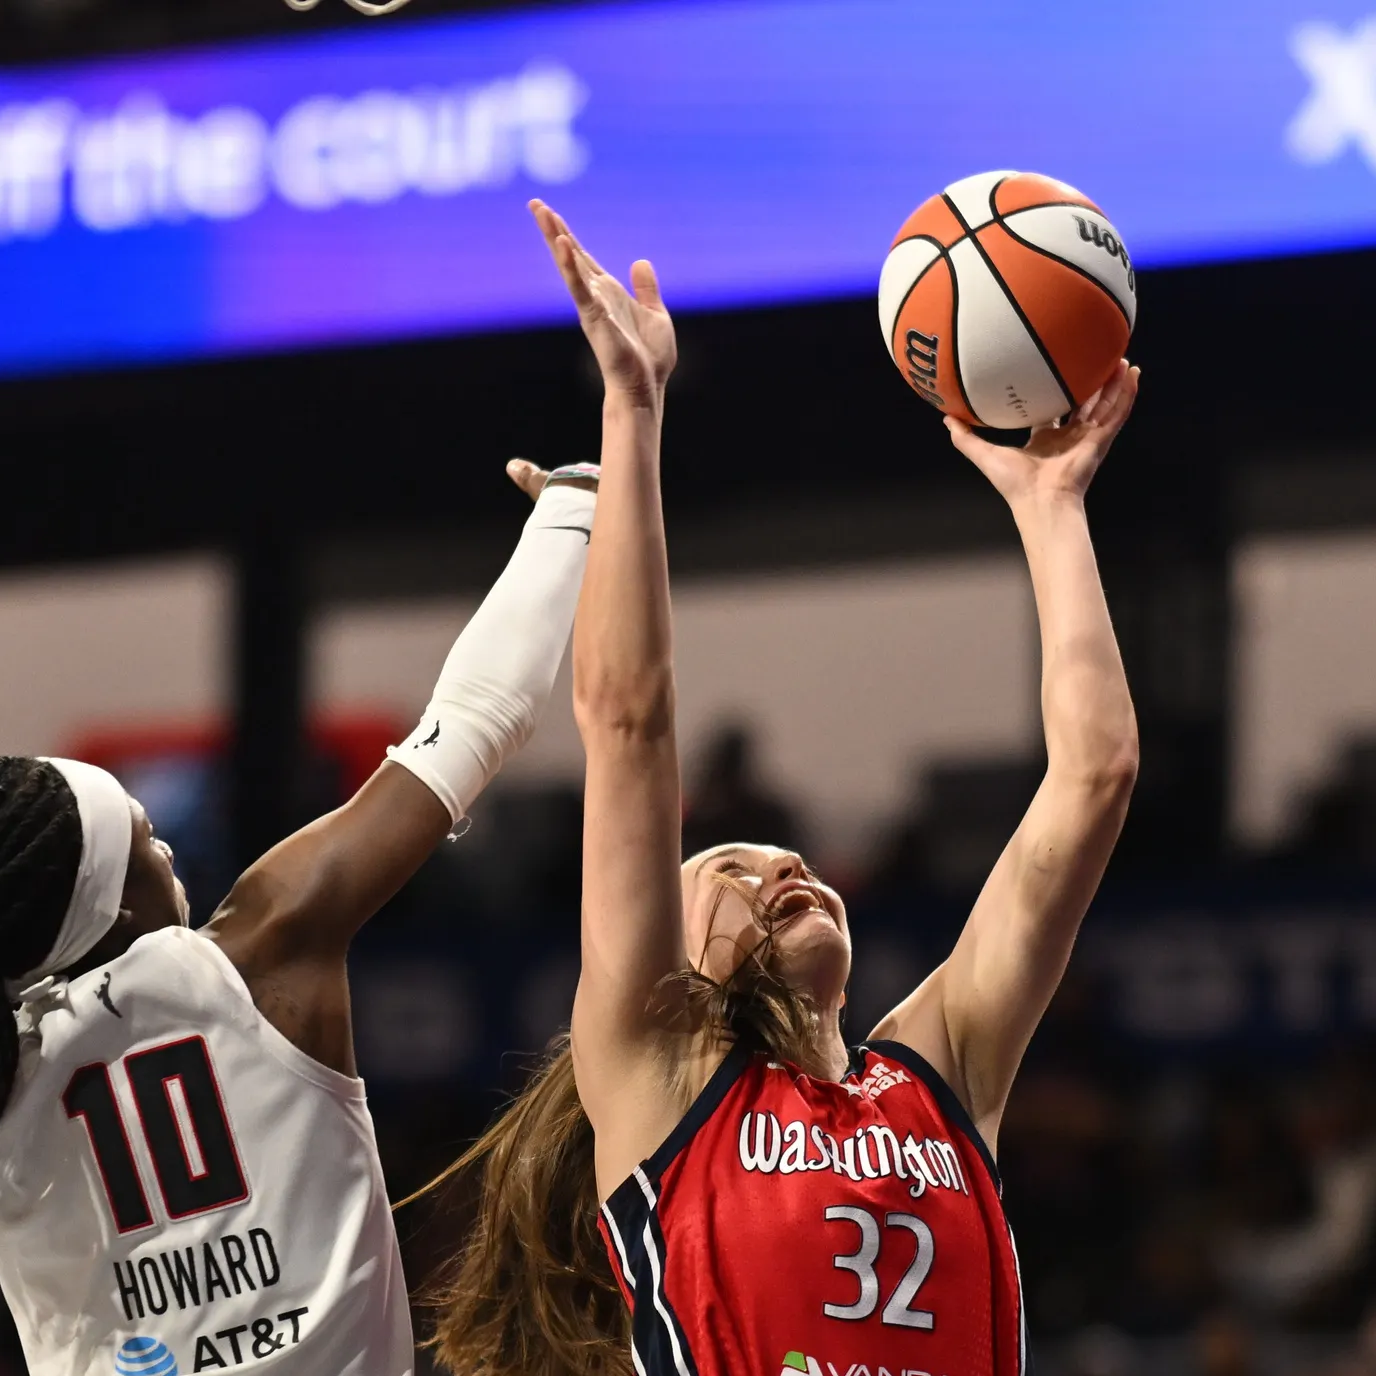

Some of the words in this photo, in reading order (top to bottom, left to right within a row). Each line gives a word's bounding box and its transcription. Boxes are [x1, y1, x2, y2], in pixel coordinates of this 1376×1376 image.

[71, 92, 272, 233] the
[272, 60, 588, 212] court
[61, 1034, 252, 1237] 10
[738, 1110, 969, 1200] Washington
[113, 1226, 281, 1322] HOWARD
[823, 1204, 936, 1331] 32
[193, 1306, 310, 1375] AT&T
